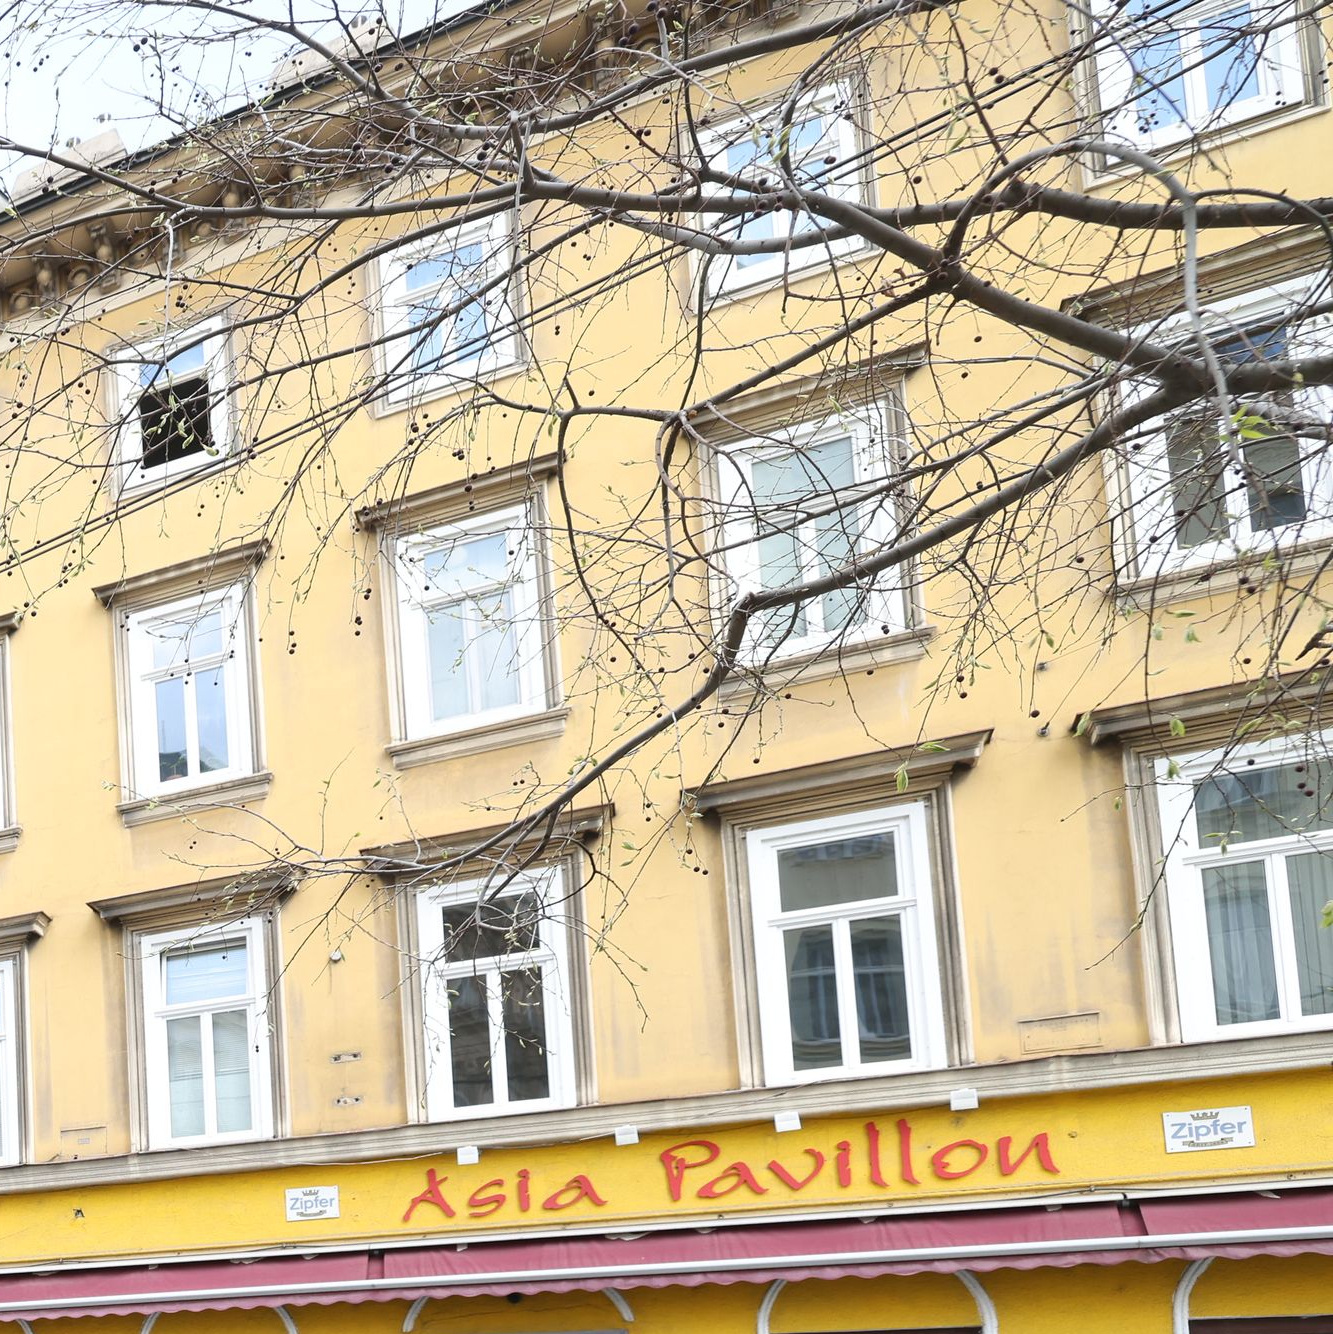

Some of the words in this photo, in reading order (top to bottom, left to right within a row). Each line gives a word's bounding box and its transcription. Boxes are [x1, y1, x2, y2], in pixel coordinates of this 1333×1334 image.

[1170, 1119, 1247, 1141] Zipfer
[403, 1168, 609, 1222] Asia
[660, 1118, 1061, 1201] Pavillon
[289, 1196, 335, 1212] Zipfer
